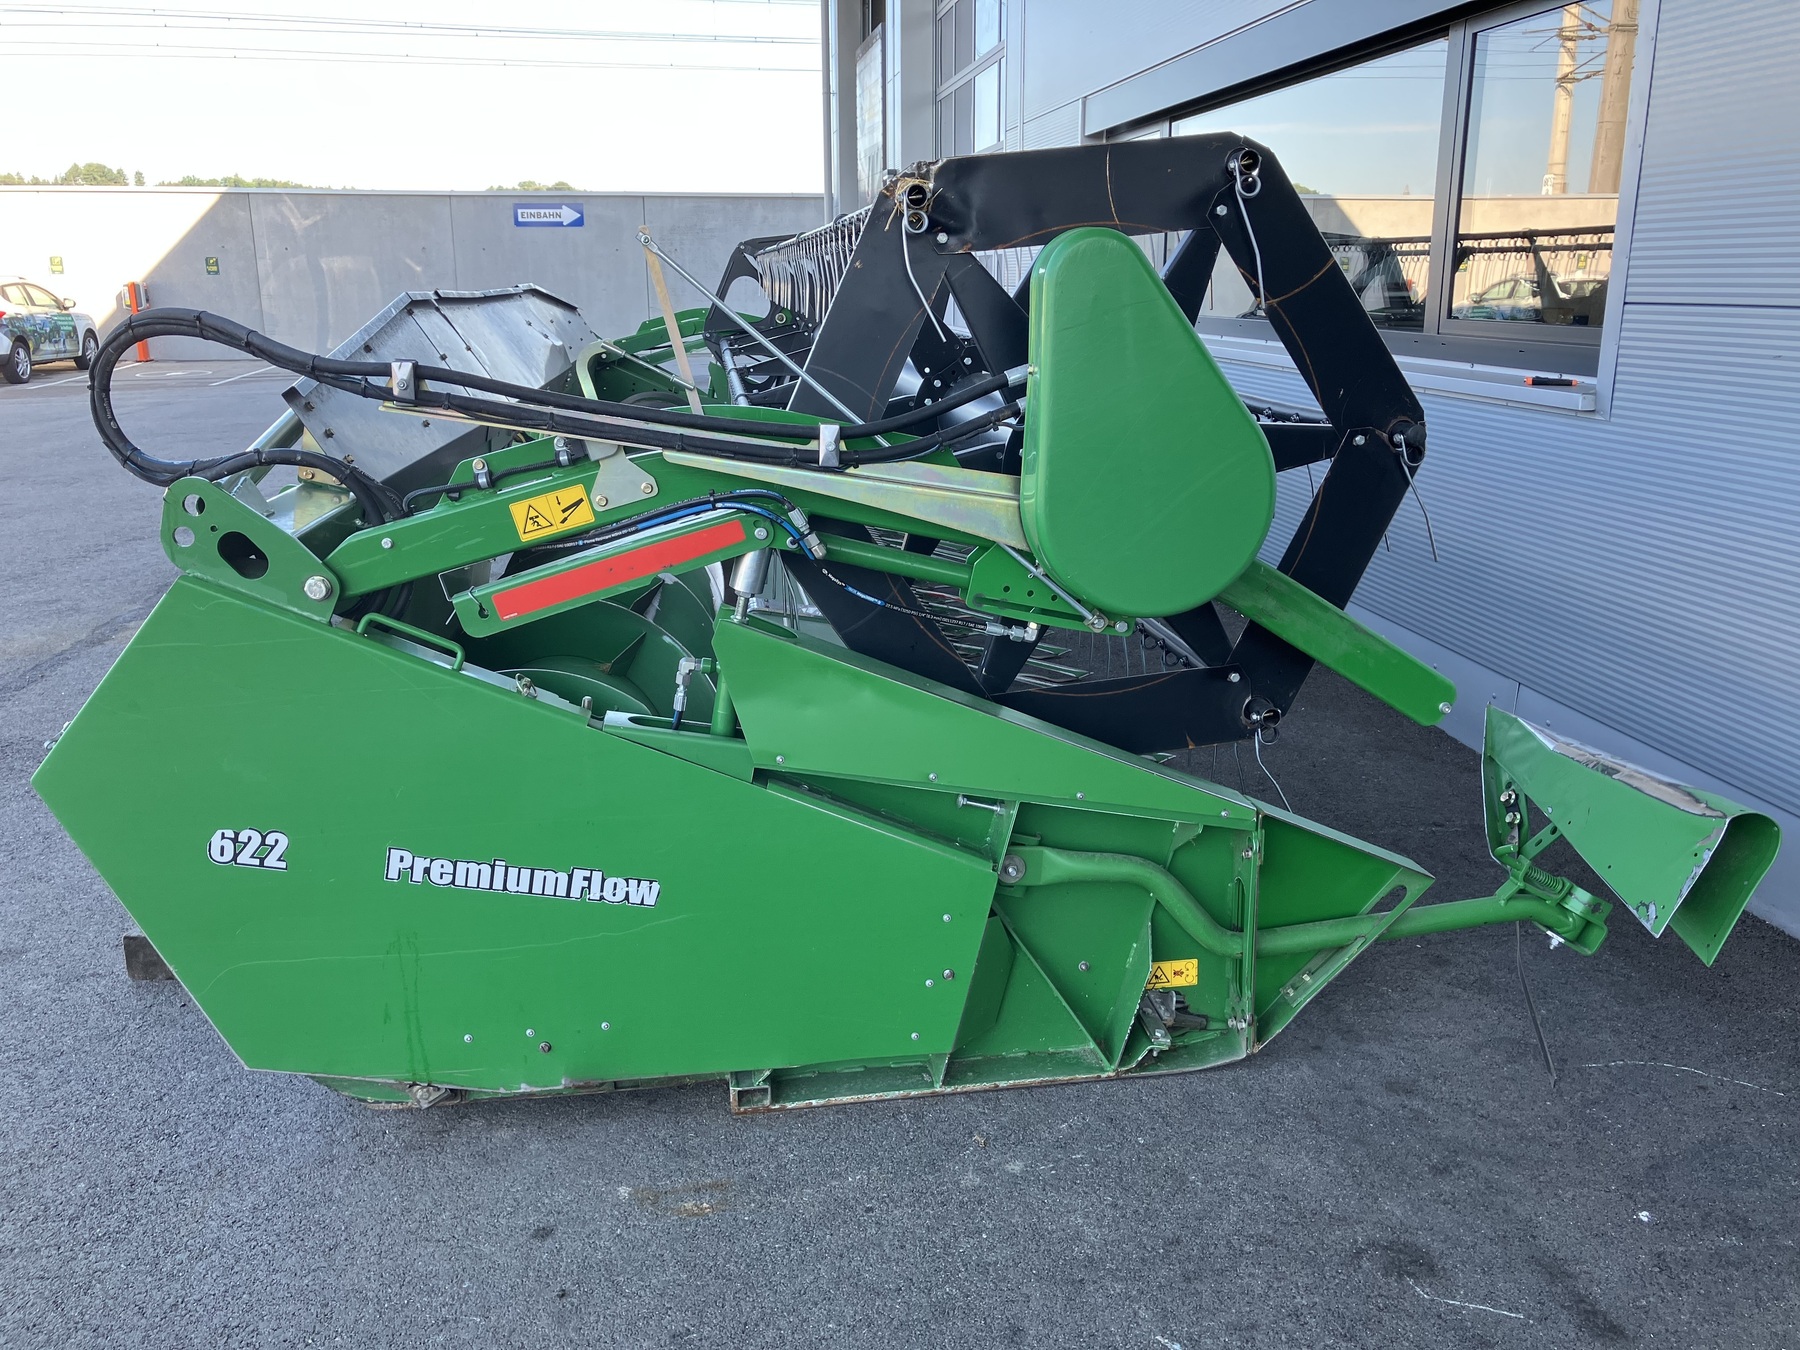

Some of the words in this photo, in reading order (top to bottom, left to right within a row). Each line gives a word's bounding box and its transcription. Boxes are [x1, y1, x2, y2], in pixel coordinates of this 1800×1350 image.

[520, 211, 562, 219] EINBAHN
[207, 828, 289, 872] 622
[384, 846, 661, 908] PremiumFlow
